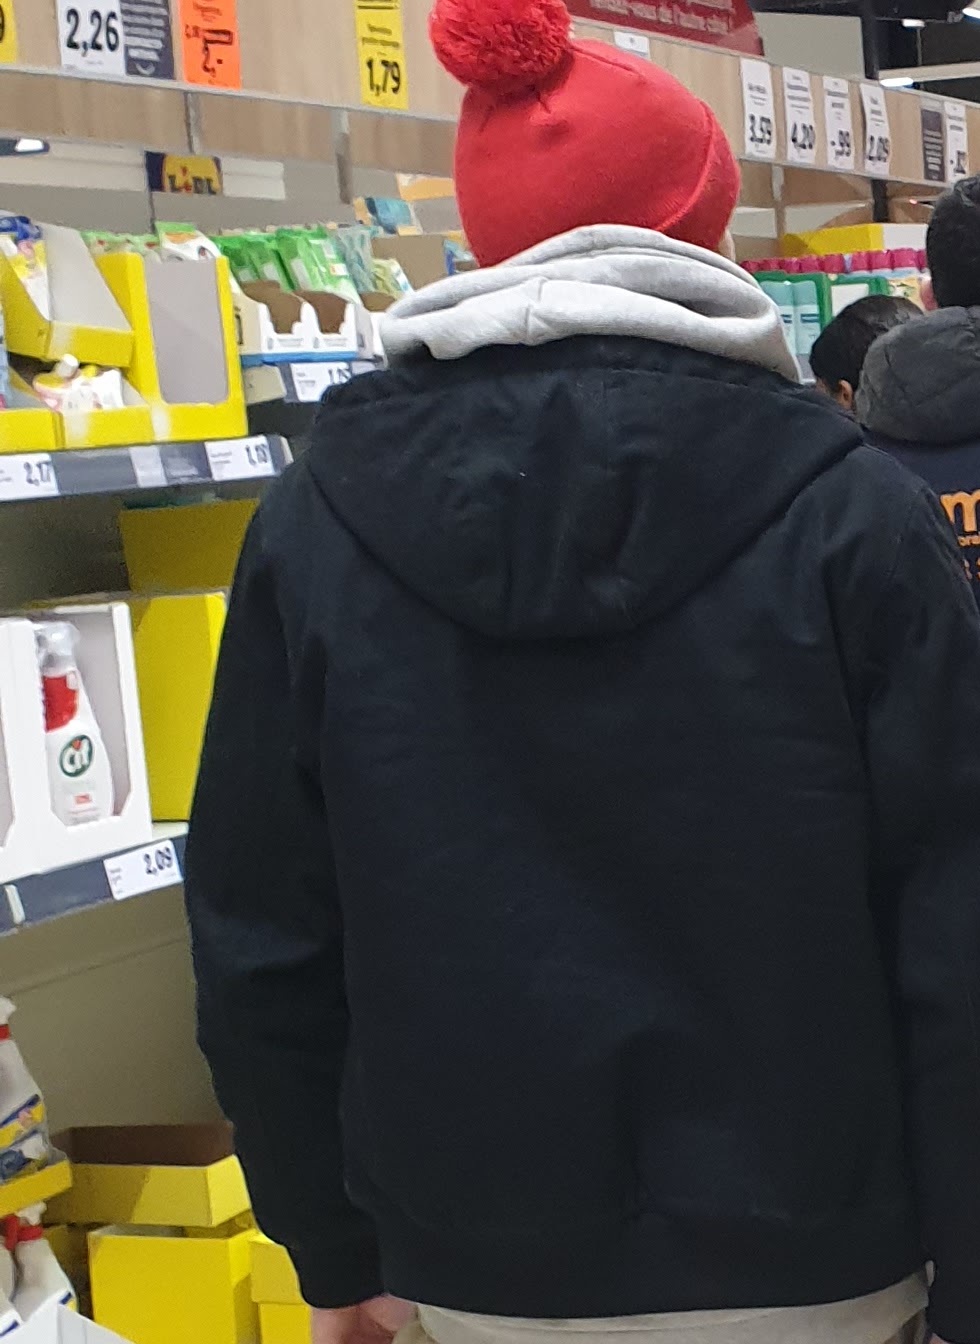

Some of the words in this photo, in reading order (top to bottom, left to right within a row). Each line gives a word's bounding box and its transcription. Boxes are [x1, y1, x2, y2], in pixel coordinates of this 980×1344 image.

[65, 8, 120, 56] 2,26
[366, 58, 401, 96] 1,79
[62, 736, 90, 773] Cif
